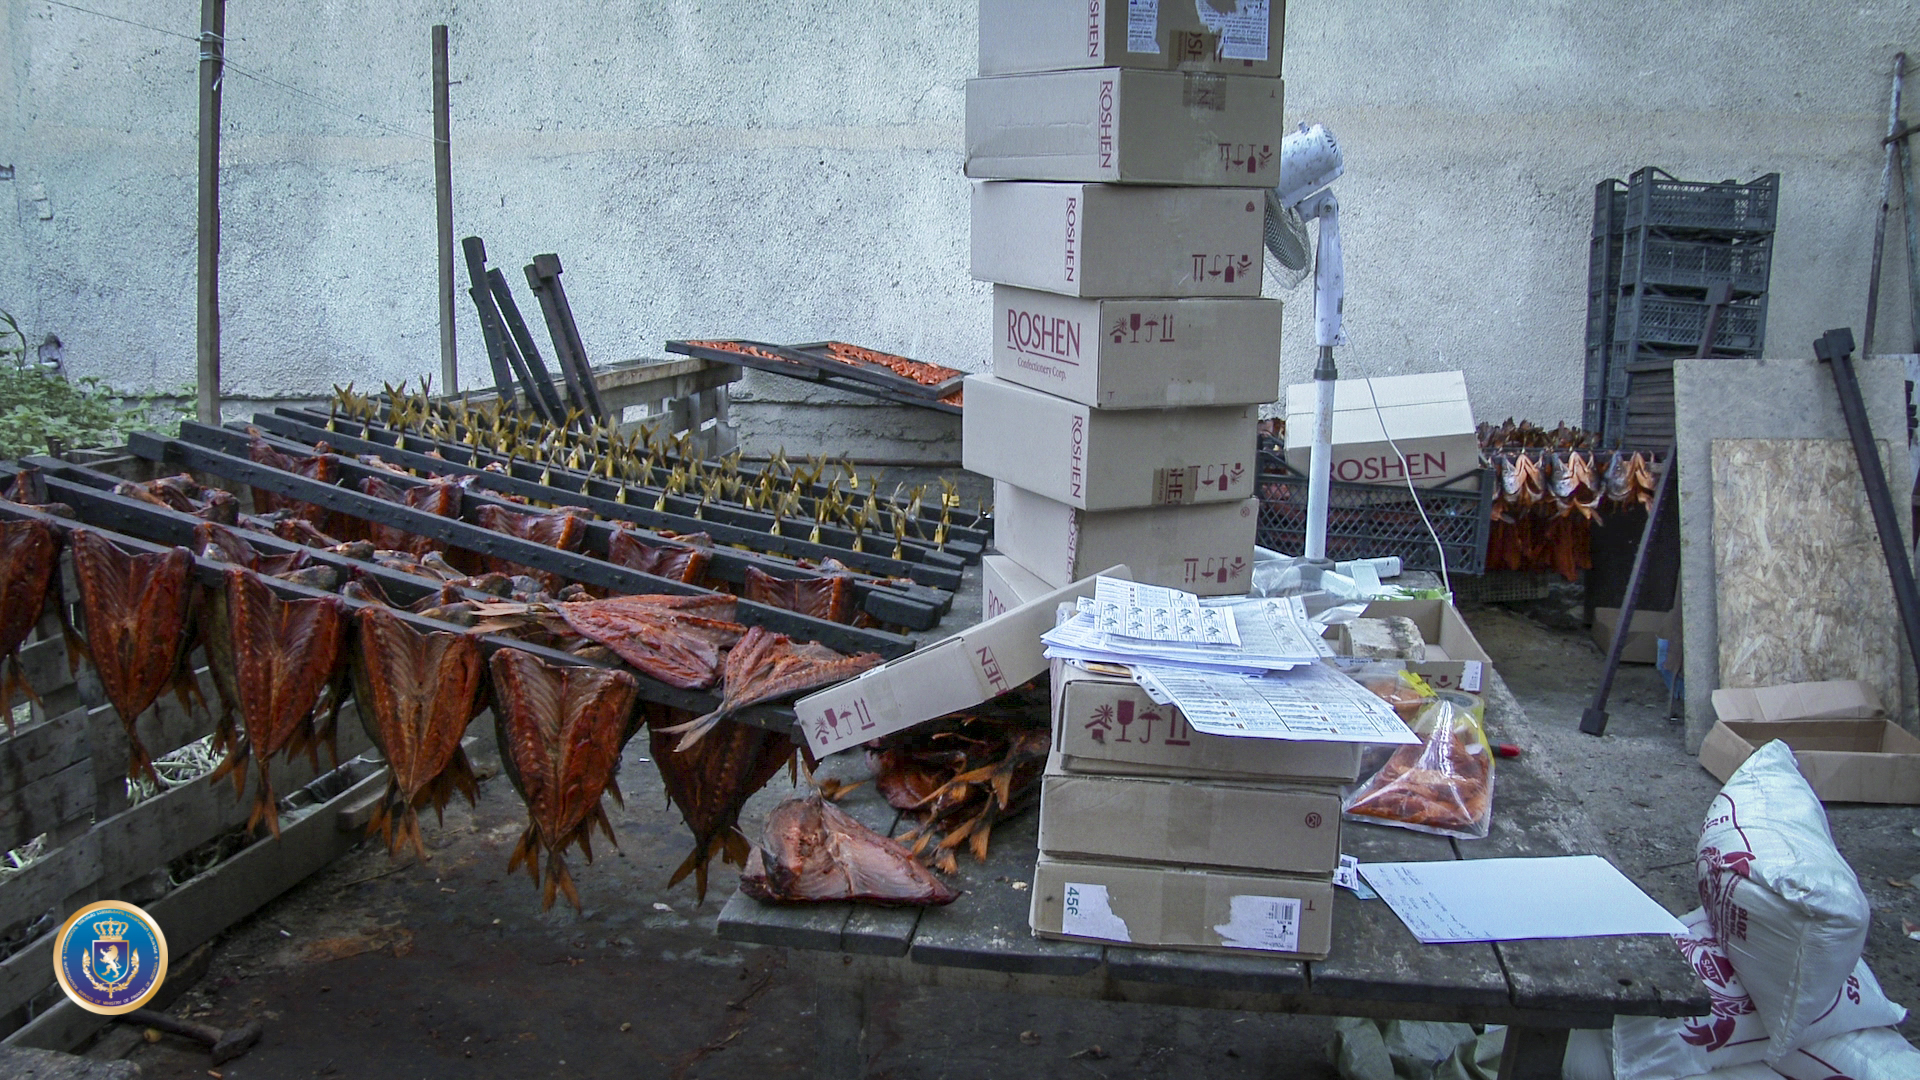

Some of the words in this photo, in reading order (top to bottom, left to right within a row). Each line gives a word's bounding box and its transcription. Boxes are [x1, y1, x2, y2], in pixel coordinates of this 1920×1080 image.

[1090, 0, 1099, 57] SHEN
[1100, 81, 1113, 169] ROSHEN
[1066, 198, 1076, 282] ROSHEN
[1008, 309, 1080, 359] ROSHEN
[1017, 357, 1051, 377] Confectionery
[1052, 366, 1067, 381] Corp.
[1072, 416, 1083, 498] ROSHEN
[1737, 907, 1748, 941] 2018
[1701, 959, 1720, 981] SALT
